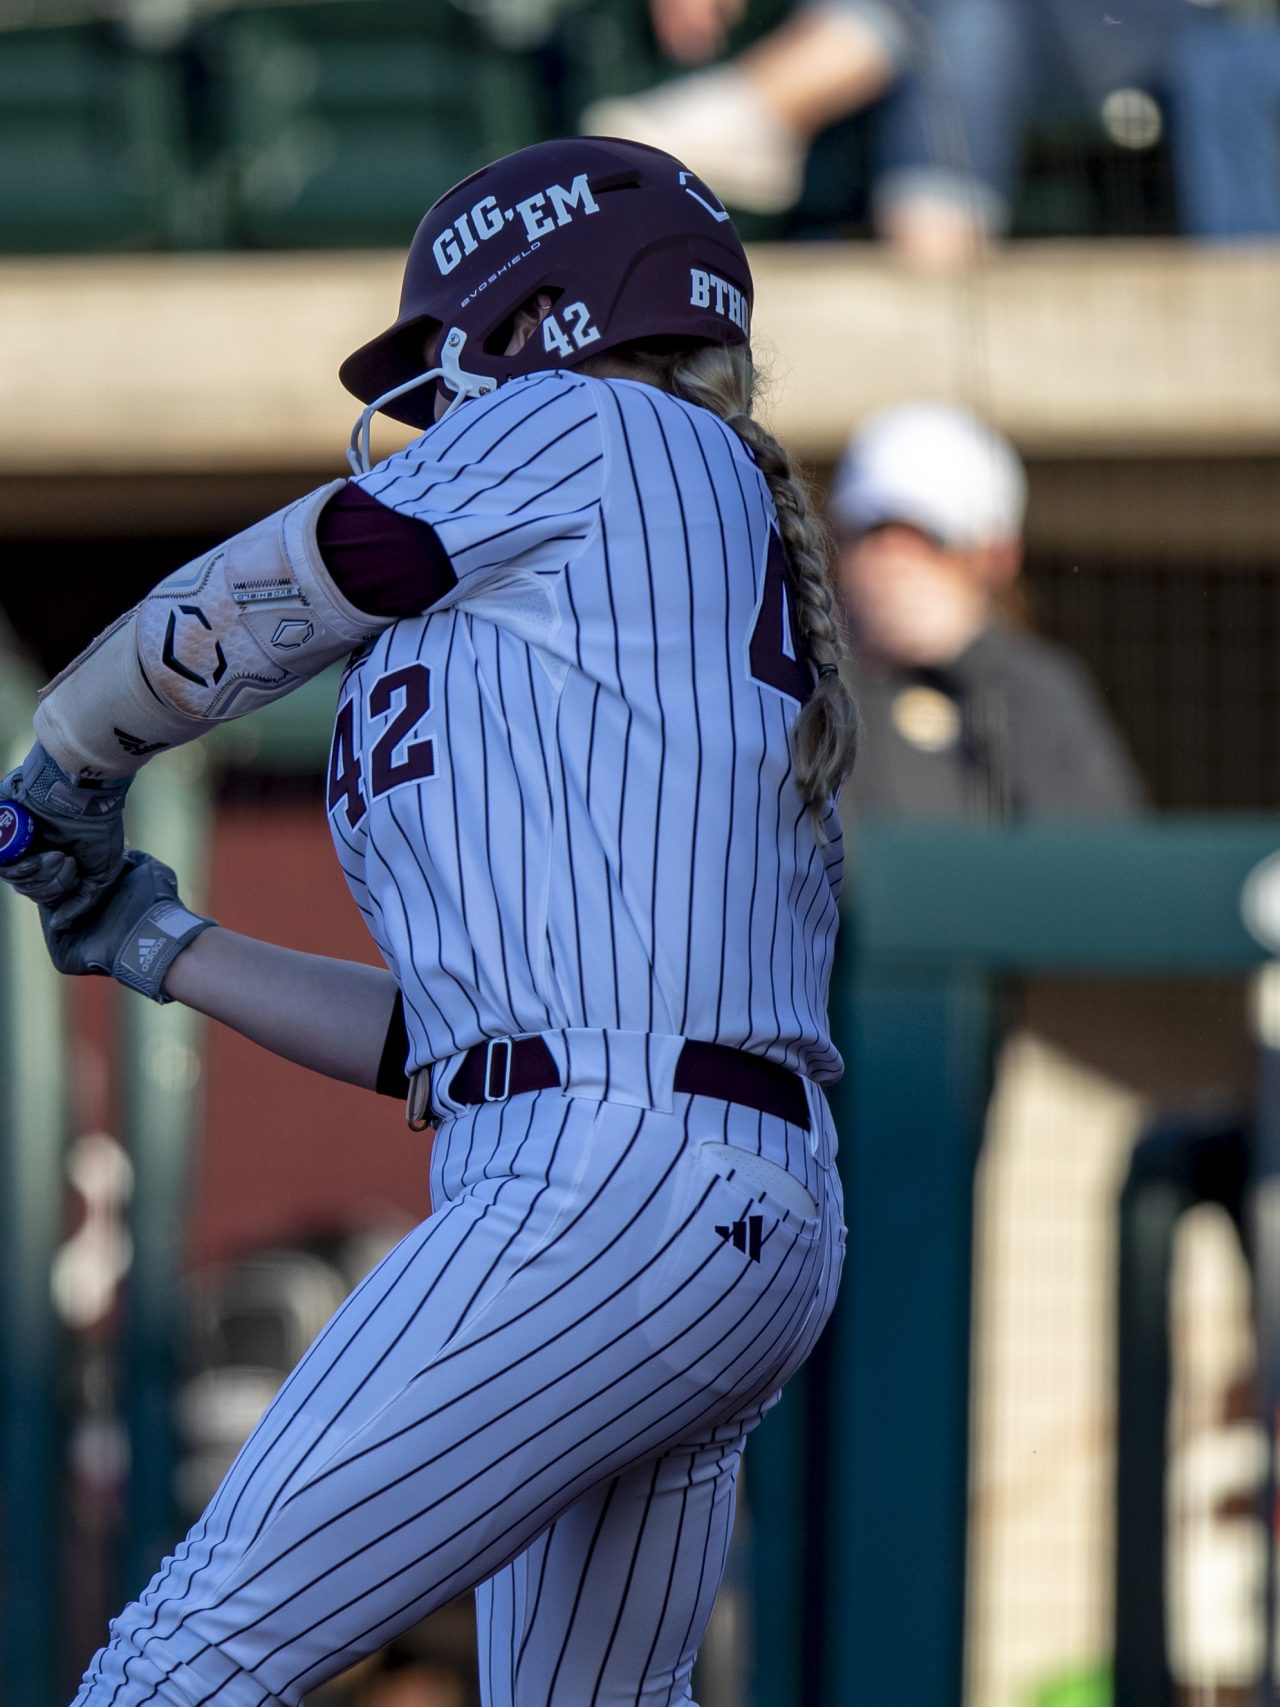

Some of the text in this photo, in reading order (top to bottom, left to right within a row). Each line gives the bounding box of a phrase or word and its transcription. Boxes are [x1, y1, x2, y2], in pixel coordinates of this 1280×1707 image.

[432, 195, 505, 276] GIG
[543, 301, 601, 357] 42
[690, 268, 748, 338] BTHO
[326, 660, 439, 833] 42
[141, 937, 167, 972] adidas
